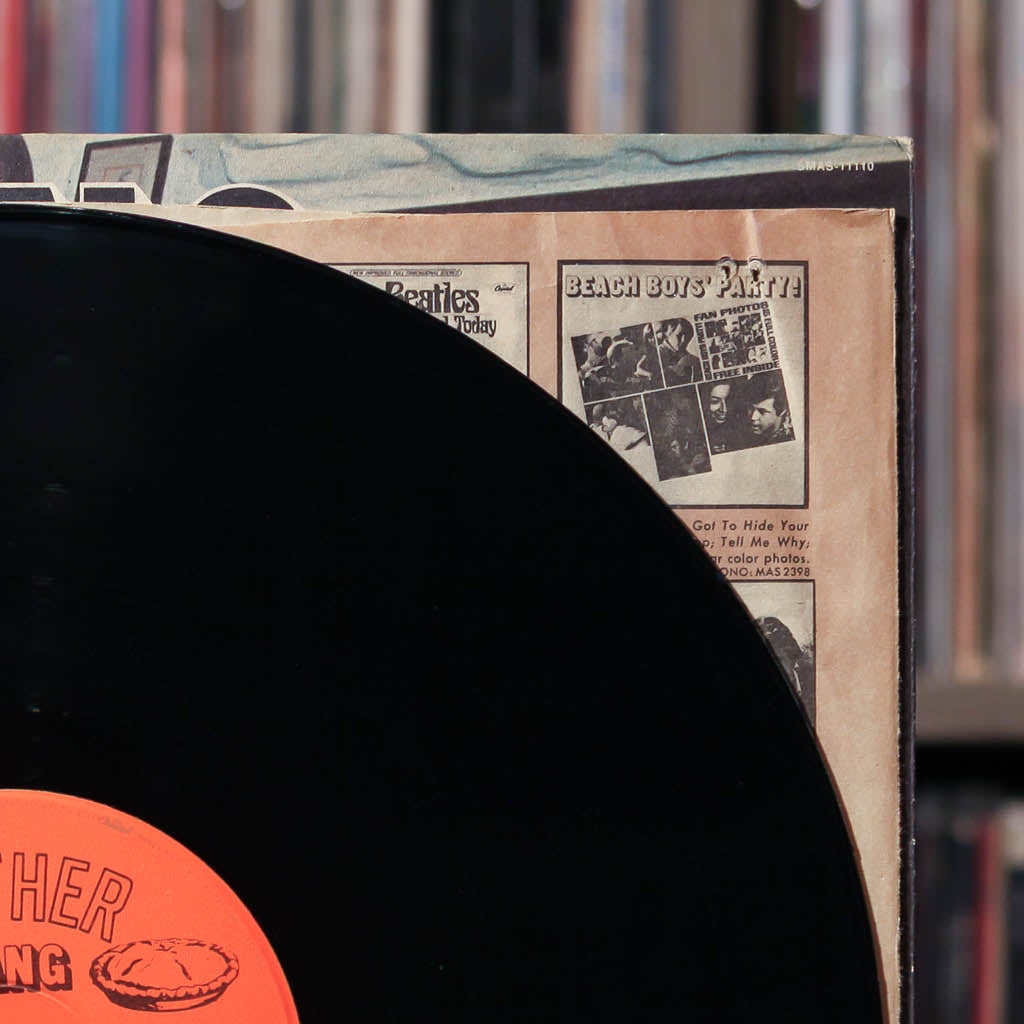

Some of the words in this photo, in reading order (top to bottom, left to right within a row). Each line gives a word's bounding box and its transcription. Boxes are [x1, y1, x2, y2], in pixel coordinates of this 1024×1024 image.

[798, 161, 874, 171] SMAS-11110
[566, 275, 640, 297] BEACH
[647, 276, 711, 297] BOYS'
[717, 275, 802, 297] PARTY!
[386, 282, 479, 313] Beatles
[694, 311, 716, 321] FAN
[720, 302, 768, 318] PHOTOS
[455, 316, 496, 337] Today
[714, 369, 740, 379] FREE
[743, 362, 780, 374] INSIDE
[693, 520, 715, 531] Got
[722, 520, 737, 530] To
[744, 520, 774, 531] Hide
[781, 520, 809, 531] Your
[721, 536, 744, 547] Tell
[751, 536, 769, 547] Me
[778, 536, 809, 550] Why;
[728, 553, 758, 563] color
[764, 553, 809, 565] photos.
[755, 567, 781, 576] MAS
[784, 567, 810, 577] 2398
